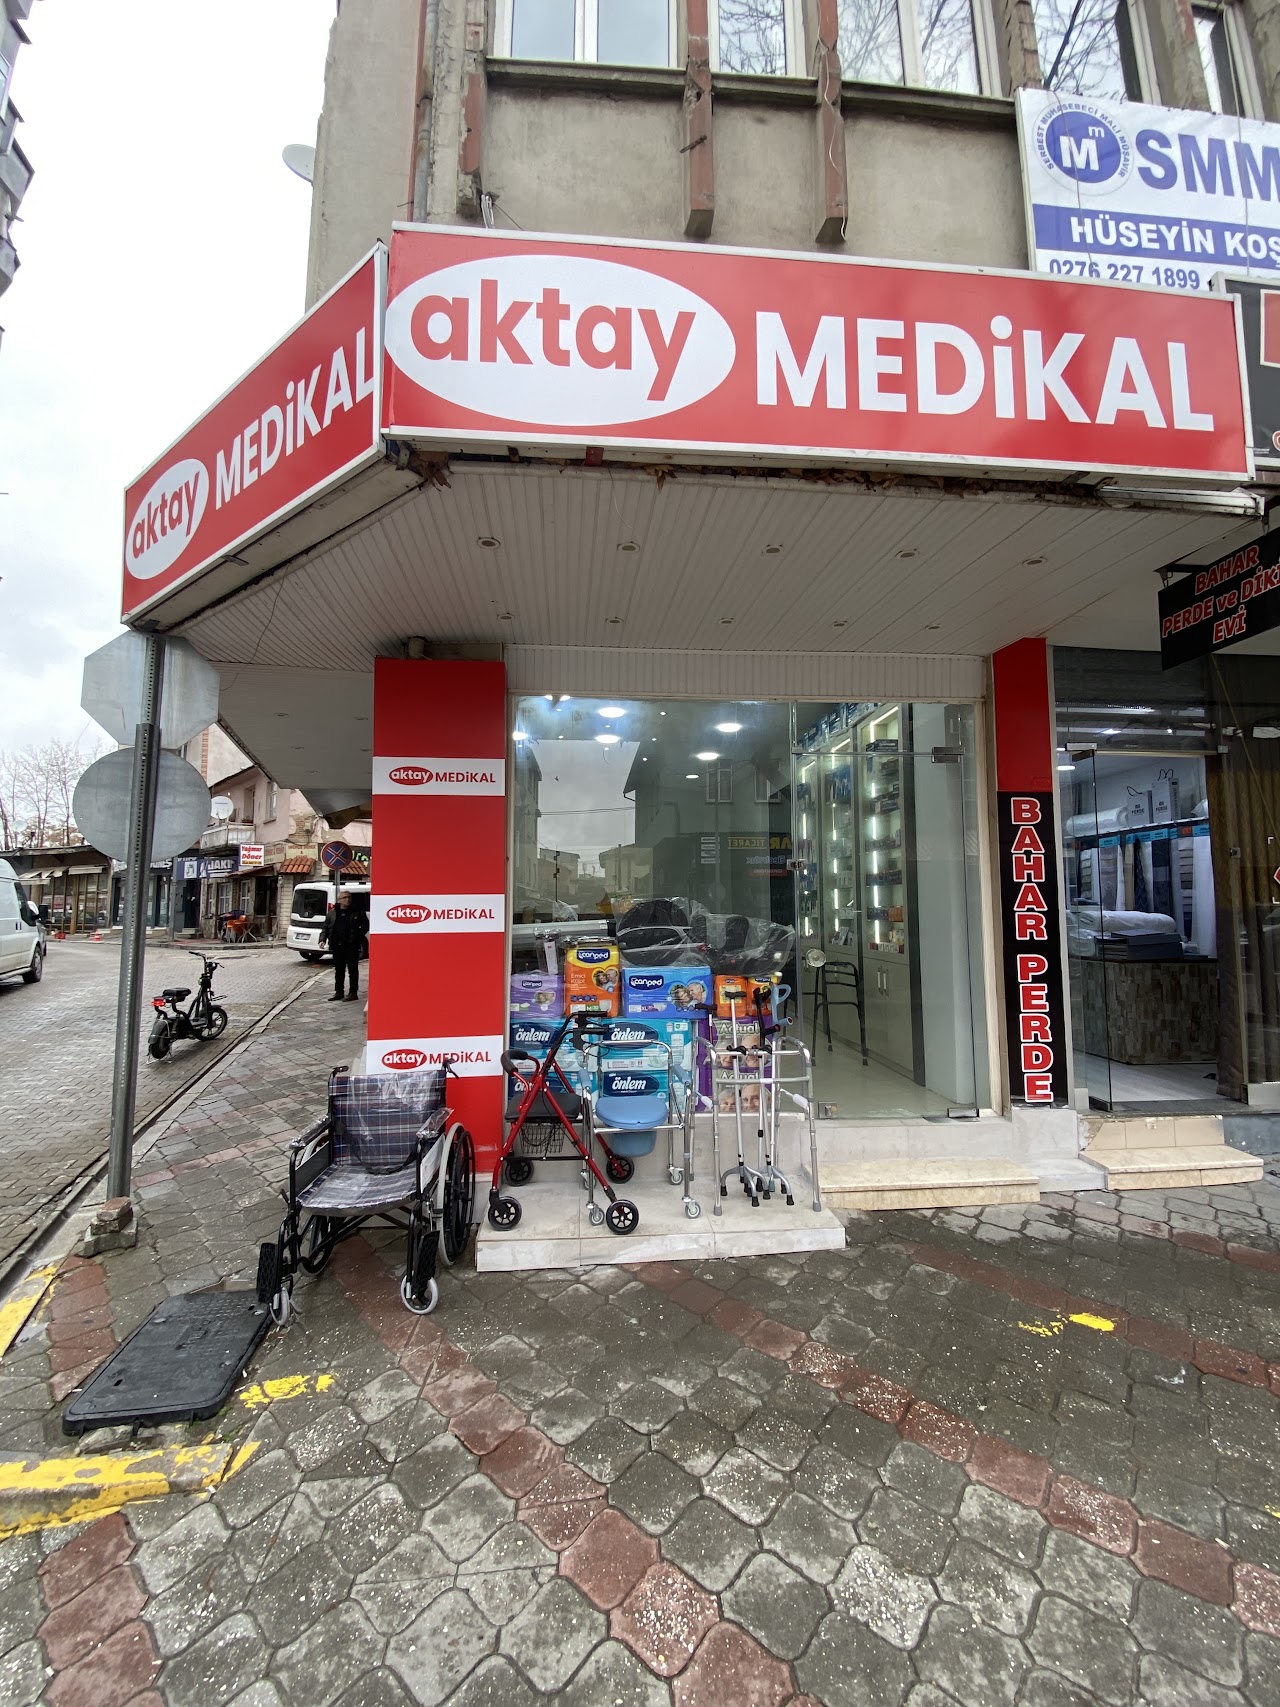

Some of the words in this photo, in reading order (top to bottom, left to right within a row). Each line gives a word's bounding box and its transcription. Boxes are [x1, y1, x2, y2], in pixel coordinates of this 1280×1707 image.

[1059, 135, 1100, 171] M
[1070, 214, 1215, 255] HÜSEYİN
[1049, 259, 1101, 279] 0276
[1106, 263, 1144, 284] 227
[1152, 267, 1200, 290] 1899
[410, 279, 697, 401] aktay
[132, 471, 200, 560] aktay
[1195, 545, 1260, 596] BAHAR
[1161, 595, 1214, 638] PERDE
[1216, 590, 1238, 613] ve
[1212, 604, 1247, 644] EVİ
[392, 768, 431, 783] aktay
[1010, 797, 1048, 940] BAHAR
[389, 907, 428, 920] aktay
[515, 1027, 550, 1041] önlem
[611, 1028, 645, 1041] önlem
[1017, 954, 1054, 1103] PERDE
[384, 1052, 425, 1066] aktay
[612, 1077, 647, 1090] önlem
